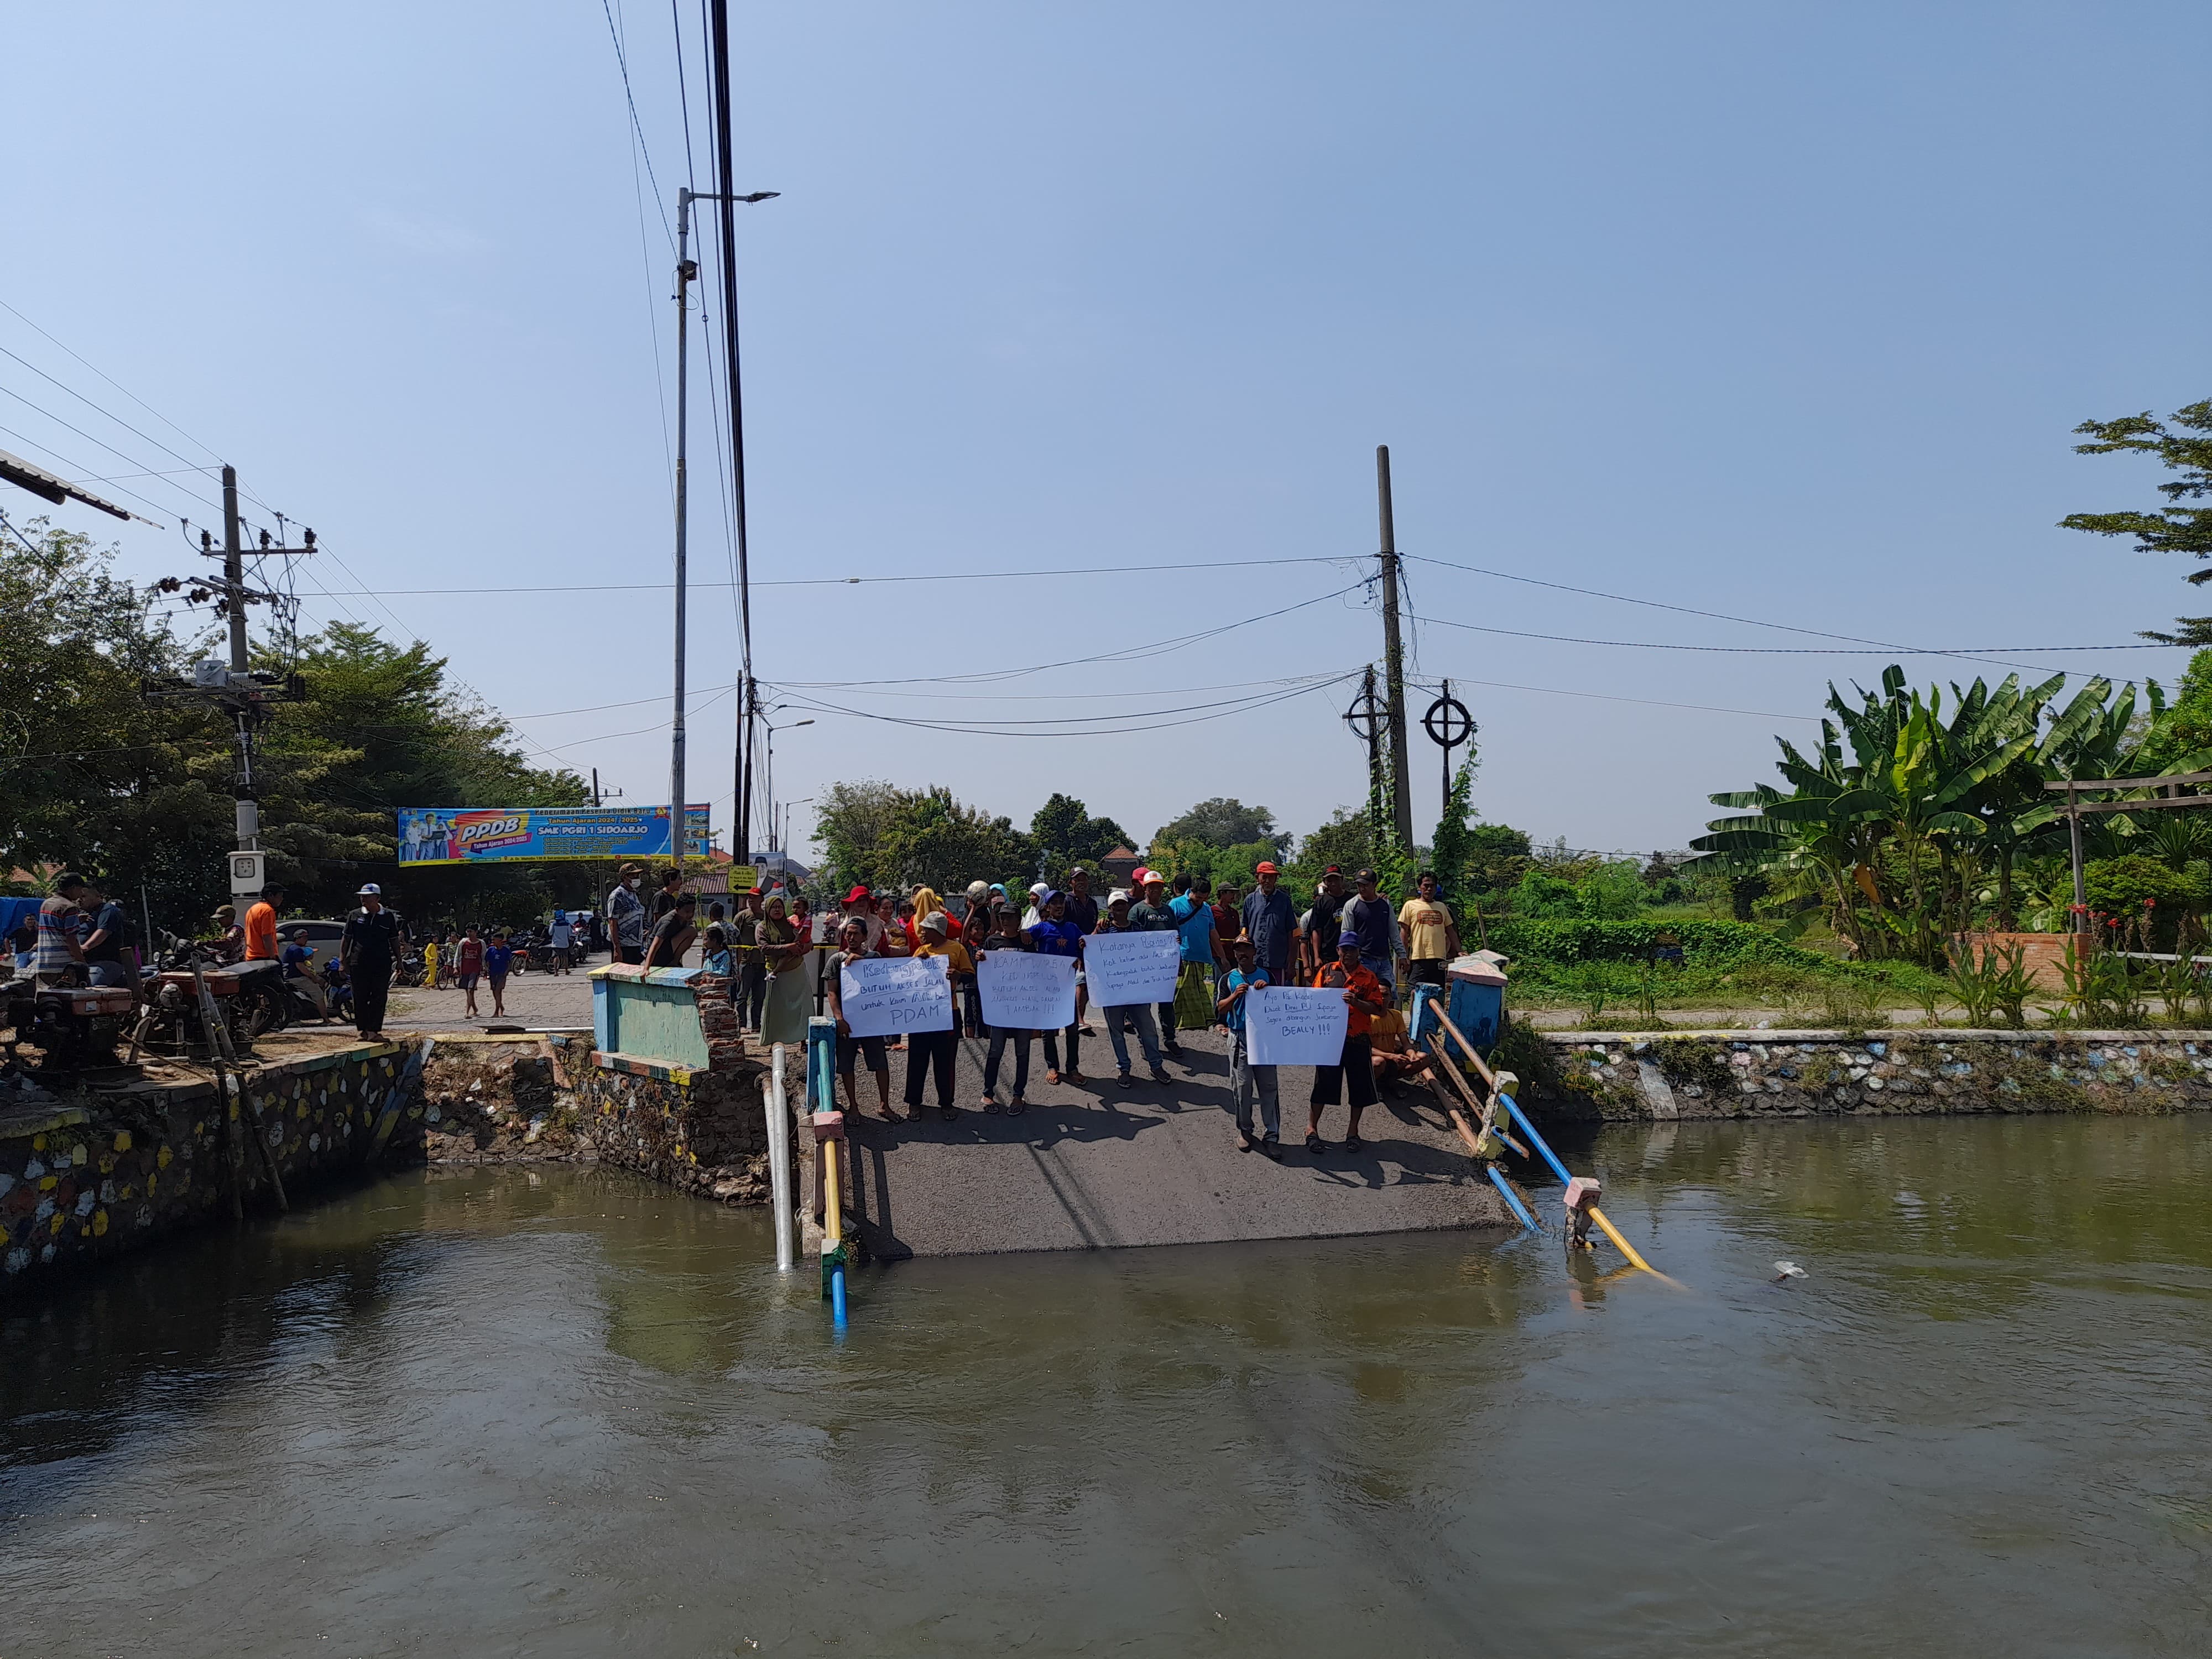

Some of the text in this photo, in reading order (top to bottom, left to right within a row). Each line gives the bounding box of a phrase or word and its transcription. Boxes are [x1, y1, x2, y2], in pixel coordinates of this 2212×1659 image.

[460, 816, 521, 842] PPDB
[537, 825, 649, 836] SMK PGRI 1 SIDOARJO
[488, 839, 504, 848] Ajaran
[994, 956, 1022, 969] KAMI
[860, 977, 945, 994] BUTUH AKSES JALAN
[1264, 991, 1277, 1004] Ayo
[861, 999, 885, 1011] untuk
[890, 1004, 939, 1025] PDAM
[1318, 1022, 1330, 1035] !!!
